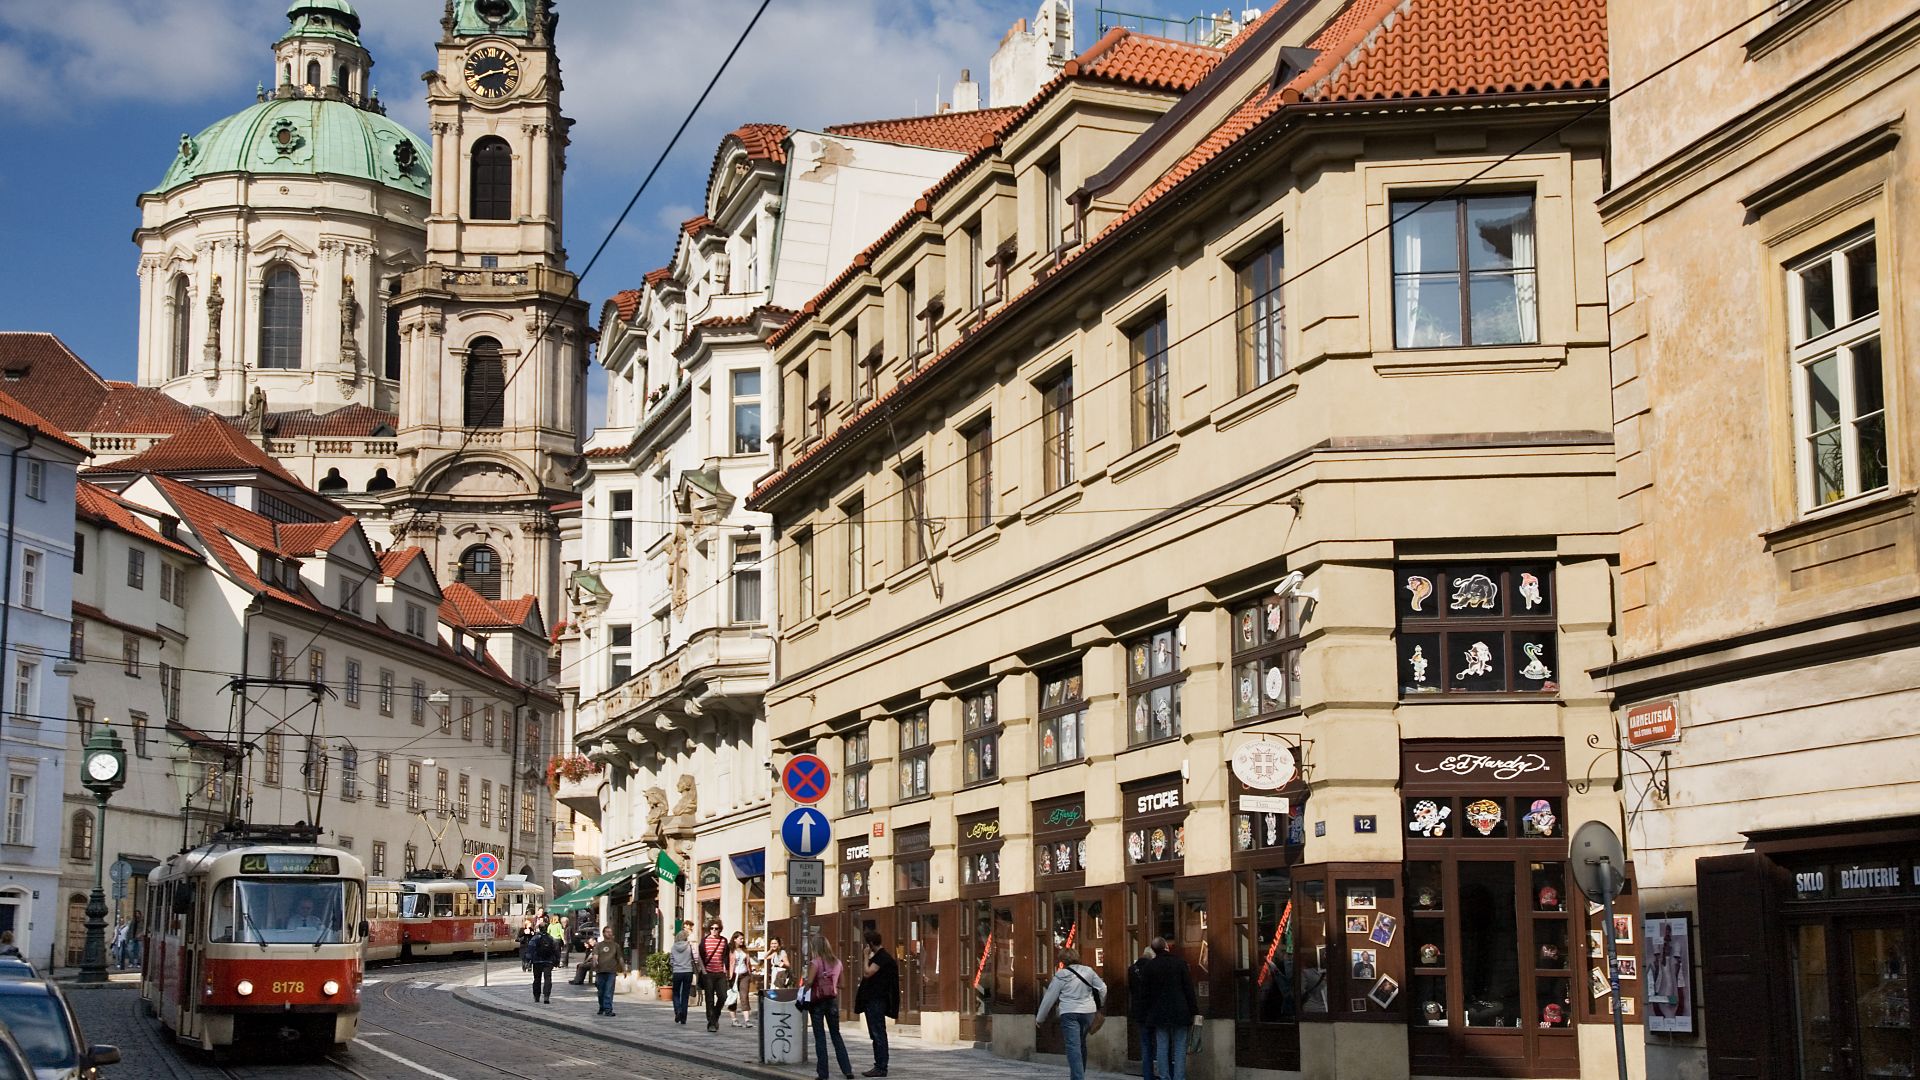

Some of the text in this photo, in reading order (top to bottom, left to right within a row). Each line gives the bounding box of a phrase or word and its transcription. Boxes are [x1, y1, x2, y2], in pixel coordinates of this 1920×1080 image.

[1630, 705, 1673, 729] KARMELITSKÁ
[1466, 754, 1533, 780] Hardy
[1137, 789, 1179, 813] STORE
[1359, 819, 1371, 830] 12
[244, 856, 267, 871] 20
[846, 844, 869, 861] STORE
[1796, 871, 1824, 892] SKLO
[1841, 866, 1900, 889] BIŽUTERIE
[1266, 900, 1292, 963] COLLECTION
[272, 981, 305, 993] 8178
